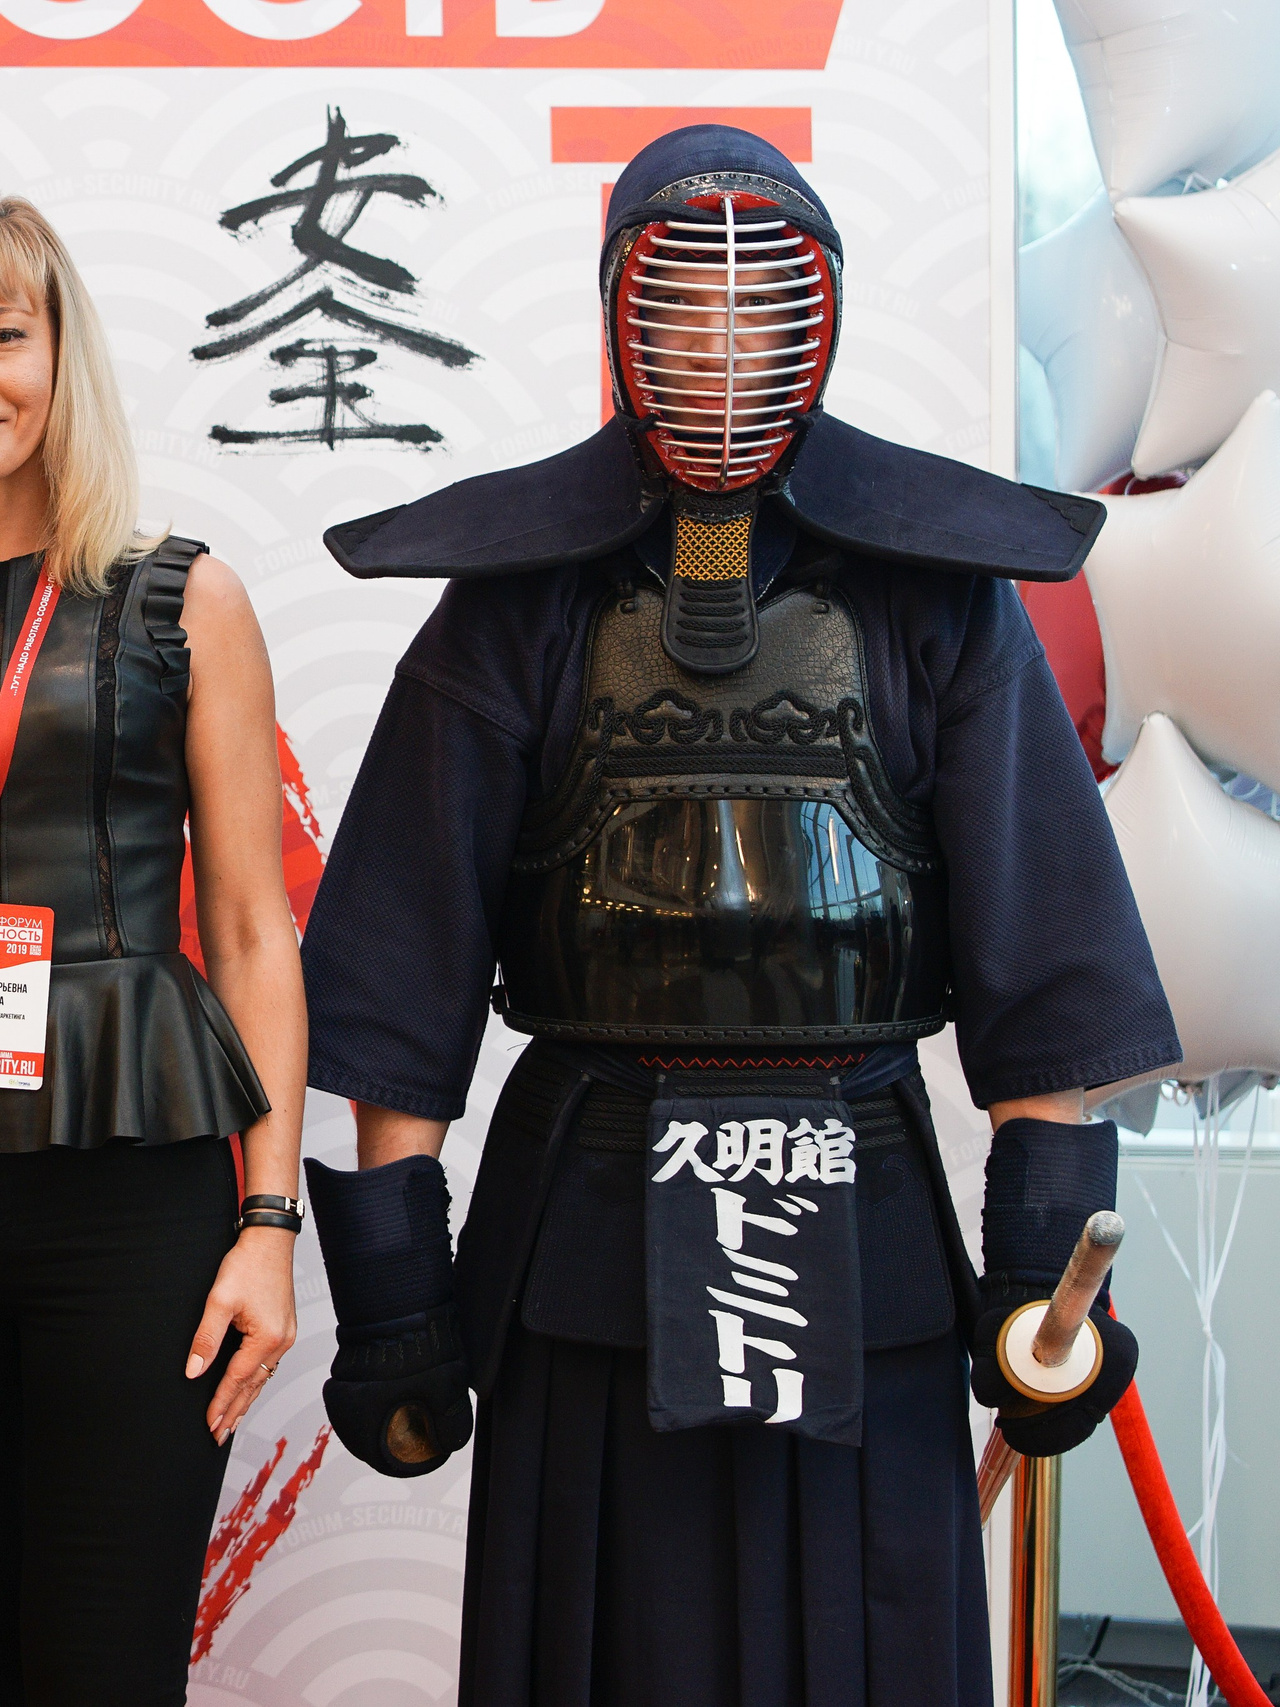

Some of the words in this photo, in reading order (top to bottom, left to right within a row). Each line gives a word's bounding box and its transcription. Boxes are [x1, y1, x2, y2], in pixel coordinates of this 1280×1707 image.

[15, 651, 29, 674] НАДО
[24, 617, 42, 651] РАБОТАТЬ
[6, 943, 28, 955] 2019
[651, 1118, 857, 1185] 久明館
[706, 1187, 819, 1424] ドミトリ
